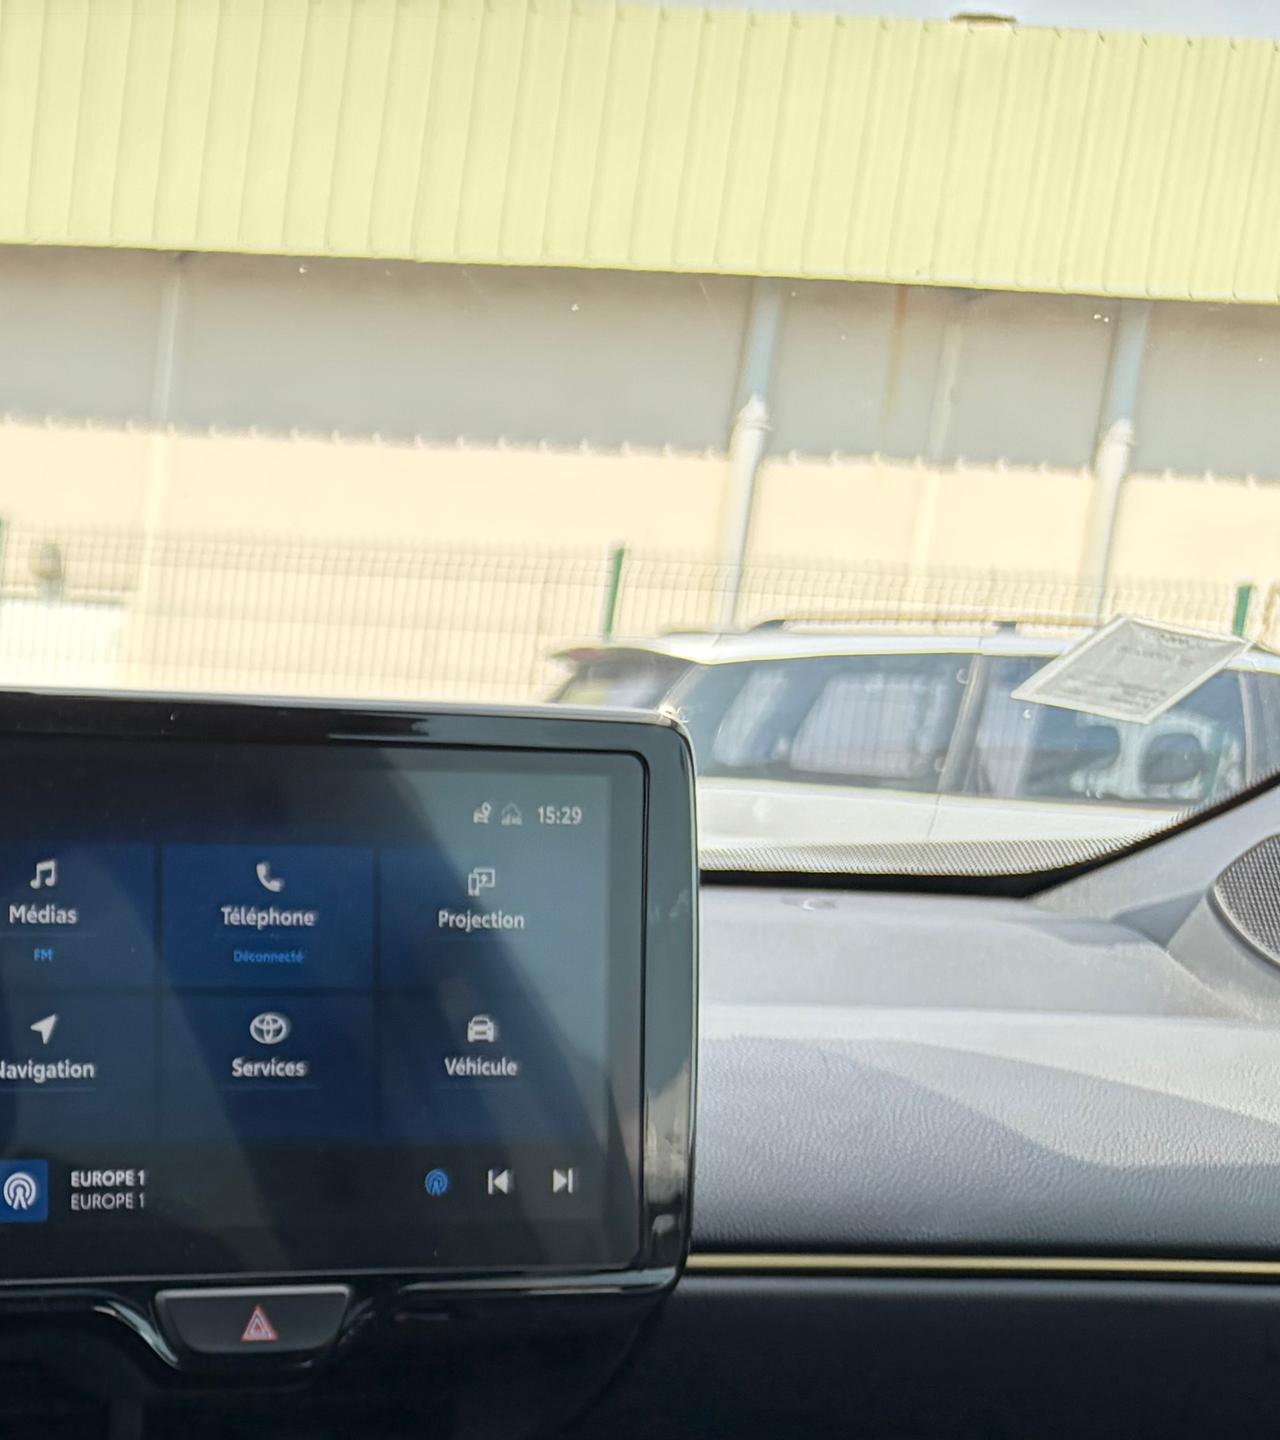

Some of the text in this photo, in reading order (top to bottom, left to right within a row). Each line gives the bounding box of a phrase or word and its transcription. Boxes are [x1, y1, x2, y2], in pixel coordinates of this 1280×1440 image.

[537, 805, 582, 825] 15:29
[8, 903, 78, 927] Médias
[221, 903, 316, 930] Téléphone
[438, 908, 525, 932] Projection
[34, 949, 53, 962] FM
[233, 948, 304, 964] Déconnecté
[231, 1057, 306, 1078] Services
[445, 1056, 518, 1077] Véhicule
[71, 1170, 134, 1188] EUROPE
[71, 1193, 134, 1210] EUROPE
